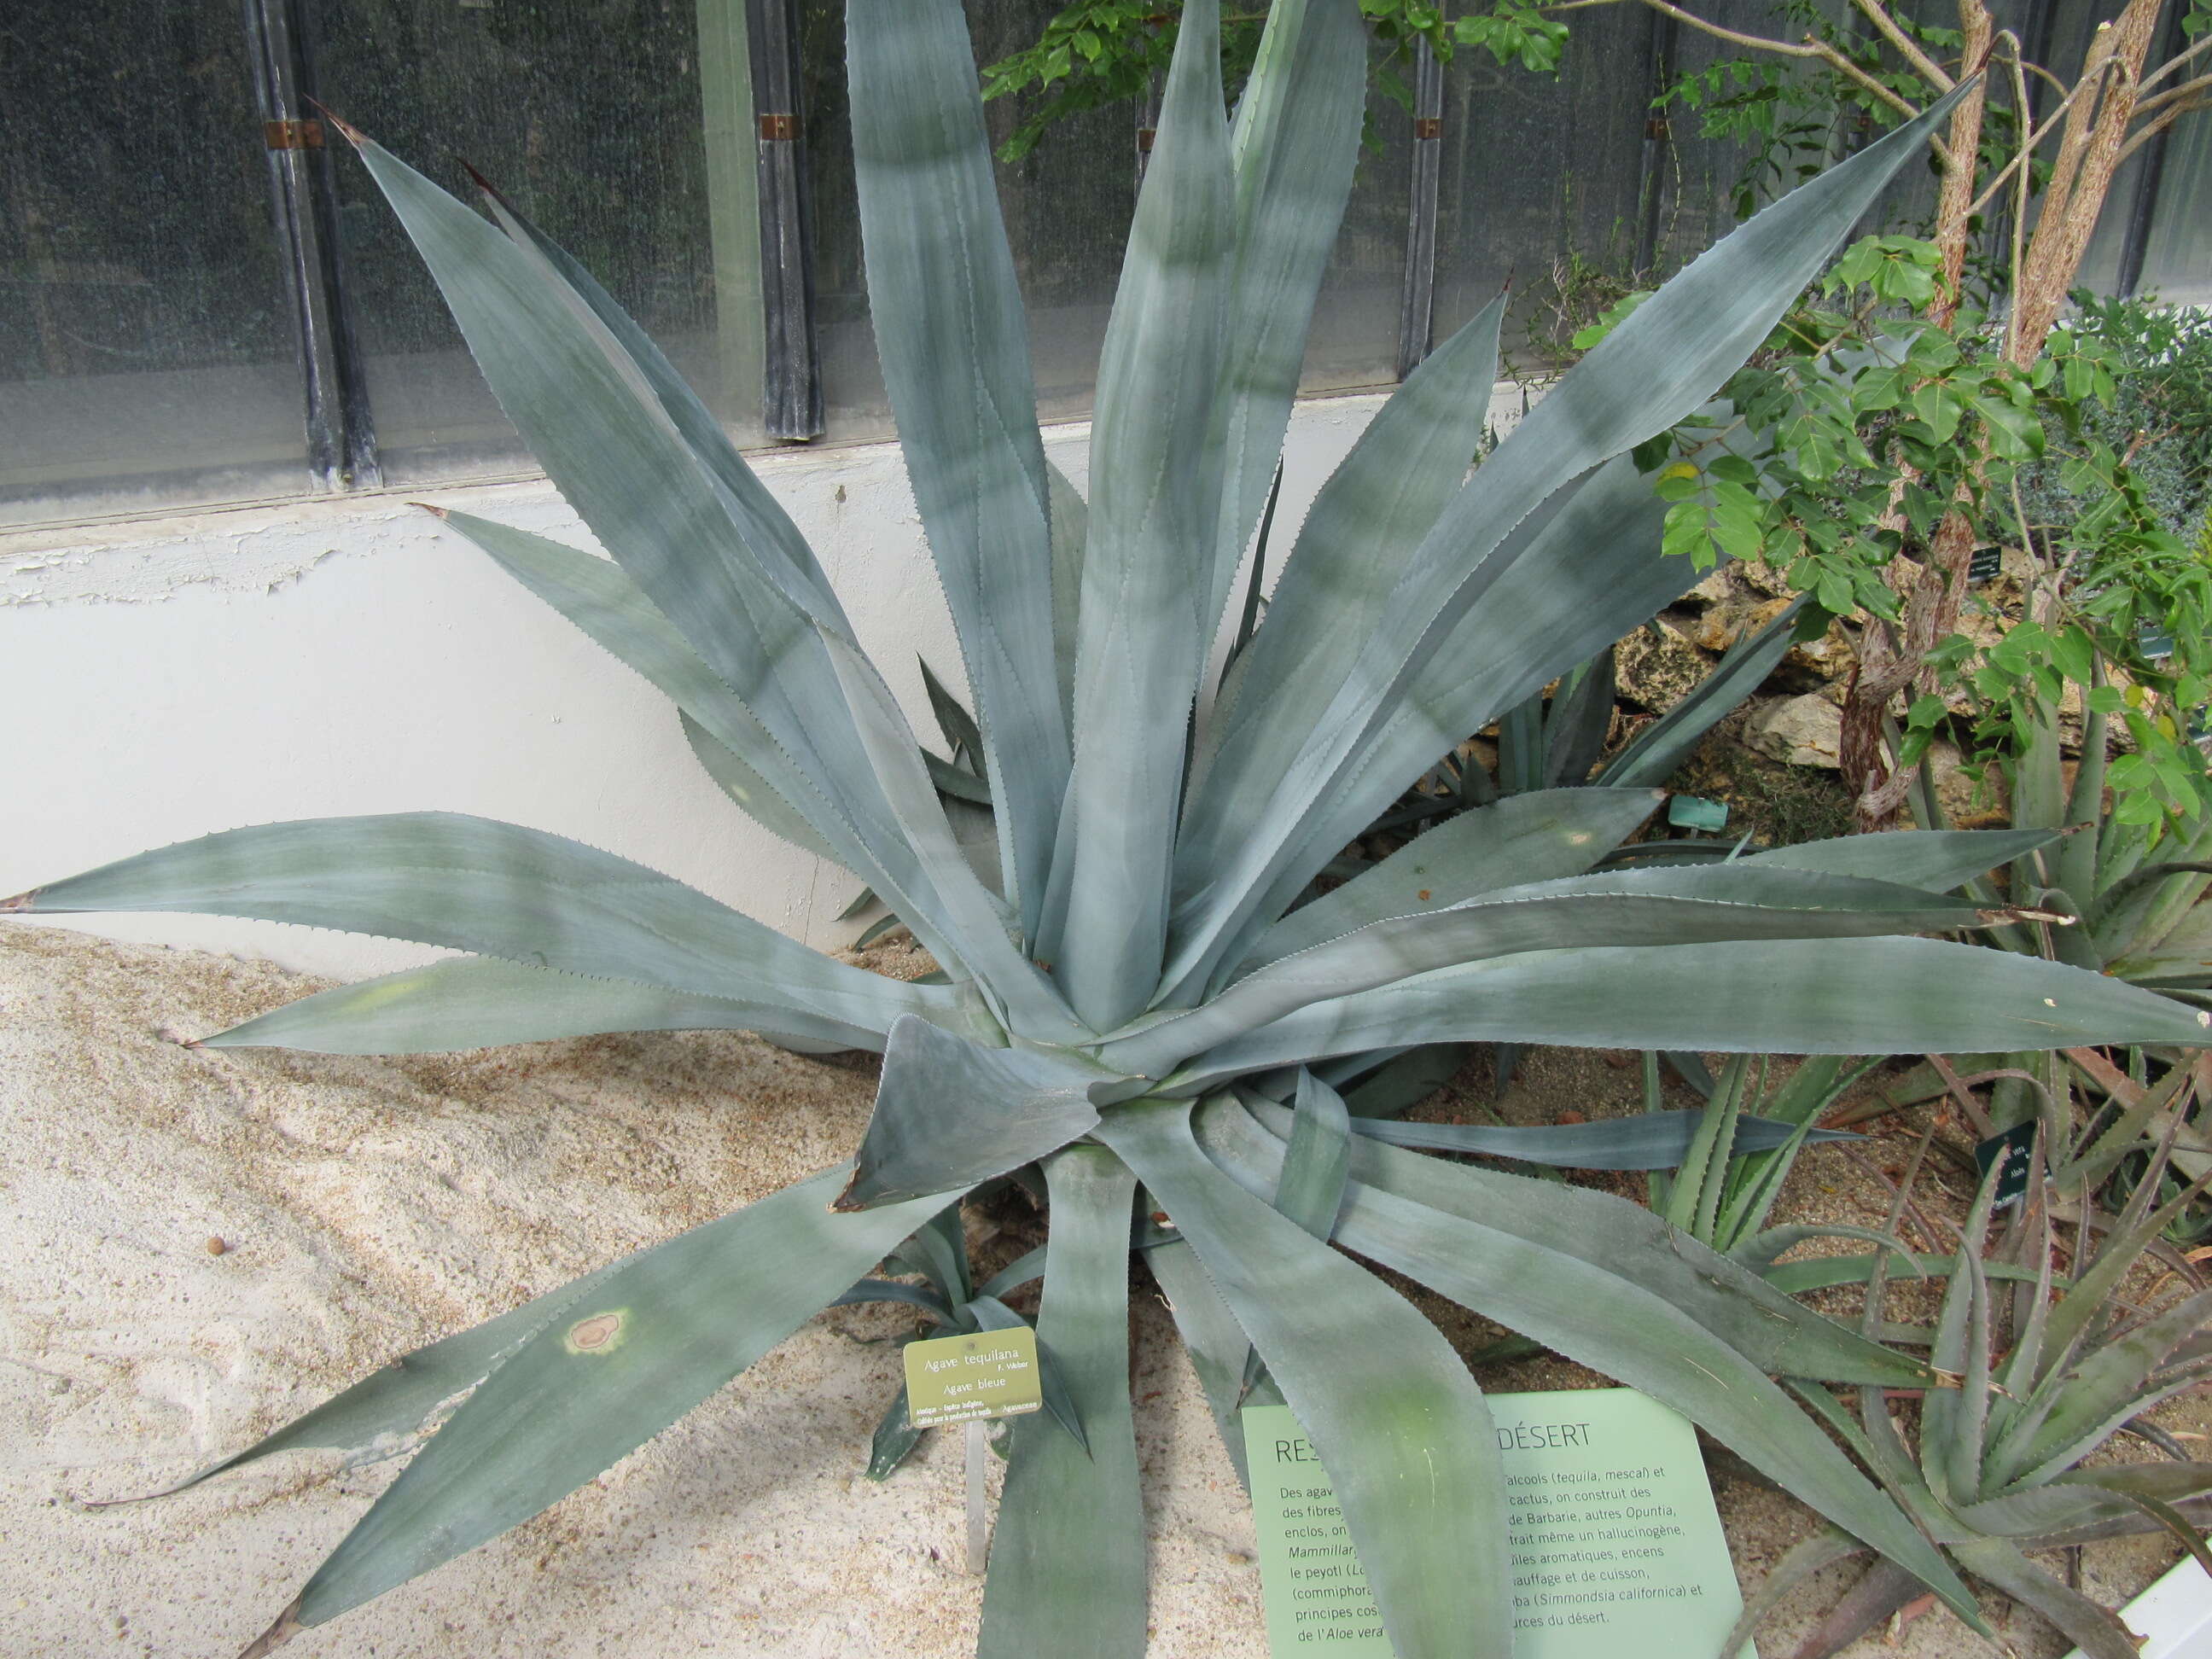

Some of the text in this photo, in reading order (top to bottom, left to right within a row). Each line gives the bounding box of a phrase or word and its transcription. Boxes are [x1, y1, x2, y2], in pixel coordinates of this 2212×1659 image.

[924, 1348, 1019, 1372] Agave tequilana
[943, 1377, 1006, 1395] Agave bleue
[1497, 1421, 1590, 1451] DÉSERT
[1280, 1466, 1665, 1499] Des agav alcools (tequila, mescal) et
[1283, 1487, 1651, 1518] des fibres cactus, on construit des
[1284, 1505, 1676, 1539] enclos, on de Barbarie, autres Opuntia,
[1509, 1532, 1534, 1545] trait
[1538, 1532, 1575, 1543] même
[1579, 1530, 1594, 1540] un
[1598, 1524, 1685, 1540] hallucinogène,
[1290, 1568, 1301, 1579] le
[1306, 1565, 1342, 1580] peyotl
[1540, 1549, 1618, 1563] aromatiques,
[1621, 1546, 1665, 1558] encens
[1565, 1572, 1577, 1582] et
[1580, 1570, 1596, 1581] de
[1599, 1567, 1650, 1580] cuisson,
[1295, 1607, 1353, 1623] principes
[1356, 1605, 1380, 1617] cos
[1534, 1591, 1615, 1607] (Simmondsia
[1618, 1585, 1687, 1601] californica)
[1691, 1584, 1703, 1595] et
[1298, 1629, 1313, 1641] de
[1318, 1627, 1353, 1640] l'Aloe
[1358, 1627, 1383, 1638] vera
[1547, 1615, 1563, 1626] du
[1567, 1611, 1610, 1625] désert.
